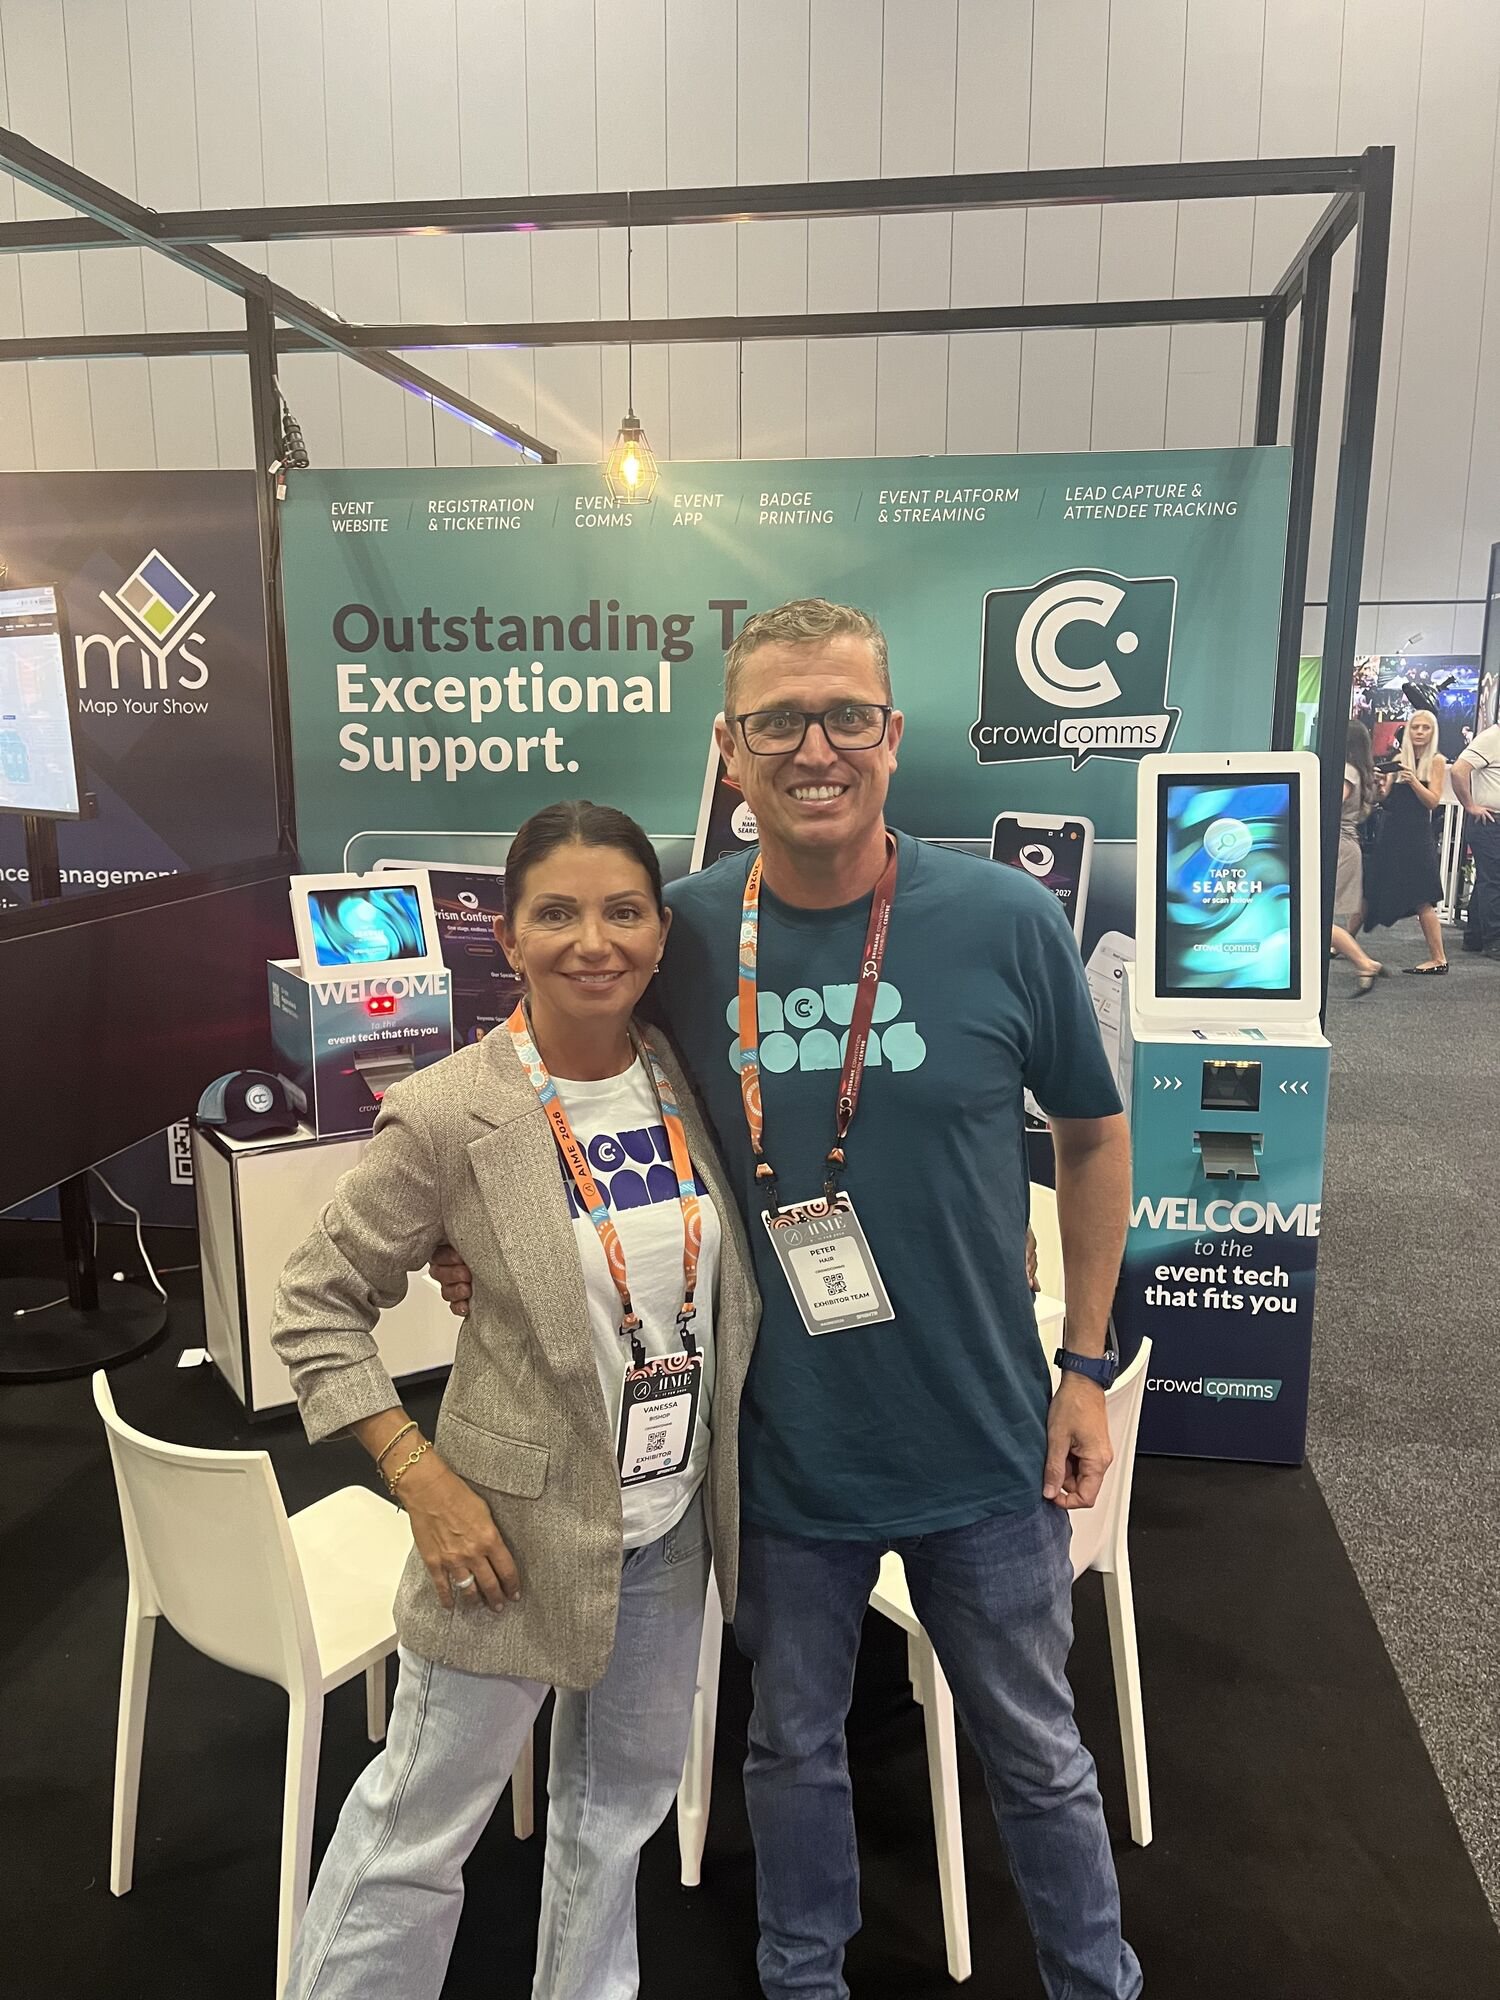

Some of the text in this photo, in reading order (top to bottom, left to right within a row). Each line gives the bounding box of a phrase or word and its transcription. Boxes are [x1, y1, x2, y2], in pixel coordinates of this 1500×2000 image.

[759, 492, 813, 507] BADGE
[878, 488, 1020, 504] EVENT PLATFORM
[1065, 483, 1203, 501] LEAD CAPTURE &
[331, 502, 374, 515] EVENT
[428, 498, 535, 514] REGISTRATION
[575, 496, 625, 510] EVENT
[674, 494, 724, 508] EVENT
[759, 510, 834, 525] PRINTING
[878, 506, 986, 522] & STREAMING
[1064, 501, 1238, 520] ATTENDEE TRACKING
[331, 518, 389, 532] WEBSITE
[428, 516, 522, 531] & TICKETING
[574, 514, 633, 528] COMMS
[672, 512, 703, 526] APP
[332, 600, 695, 663] Outstanding
[336, 661, 671, 722] Exceptional
[78, 698, 209, 716] Map Your Show
[338, 722, 580, 782] Support.
[60, 870, 178, 888] anageme
[1210, 868, 1247, 878] TAP TO
[1054, 888, 1072, 897] 2027
[1192, 880, 1262, 894] SEARCH
[313, 974, 448, 1006] WELCOME
[328, 1026, 438, 1045] event tech that fits you
[552, 1110, 587, 1177] AIME 2026
[1130, 1196, 1322, 1237] WELCOME
[810, 1246, 836, 1256] PETER
[1194, 1238, 1254, 1258] to the
[1154, 1264, 1290, 1288] event tech
[814, 1292, 870, 1309] EXHIBITOR TEAM
[1144, 1285, 1298, 1316] that fits you
[644, 1401, 678, 1414] VANESSA
[636, 1450, 672, 1464] EXHIBITOR
